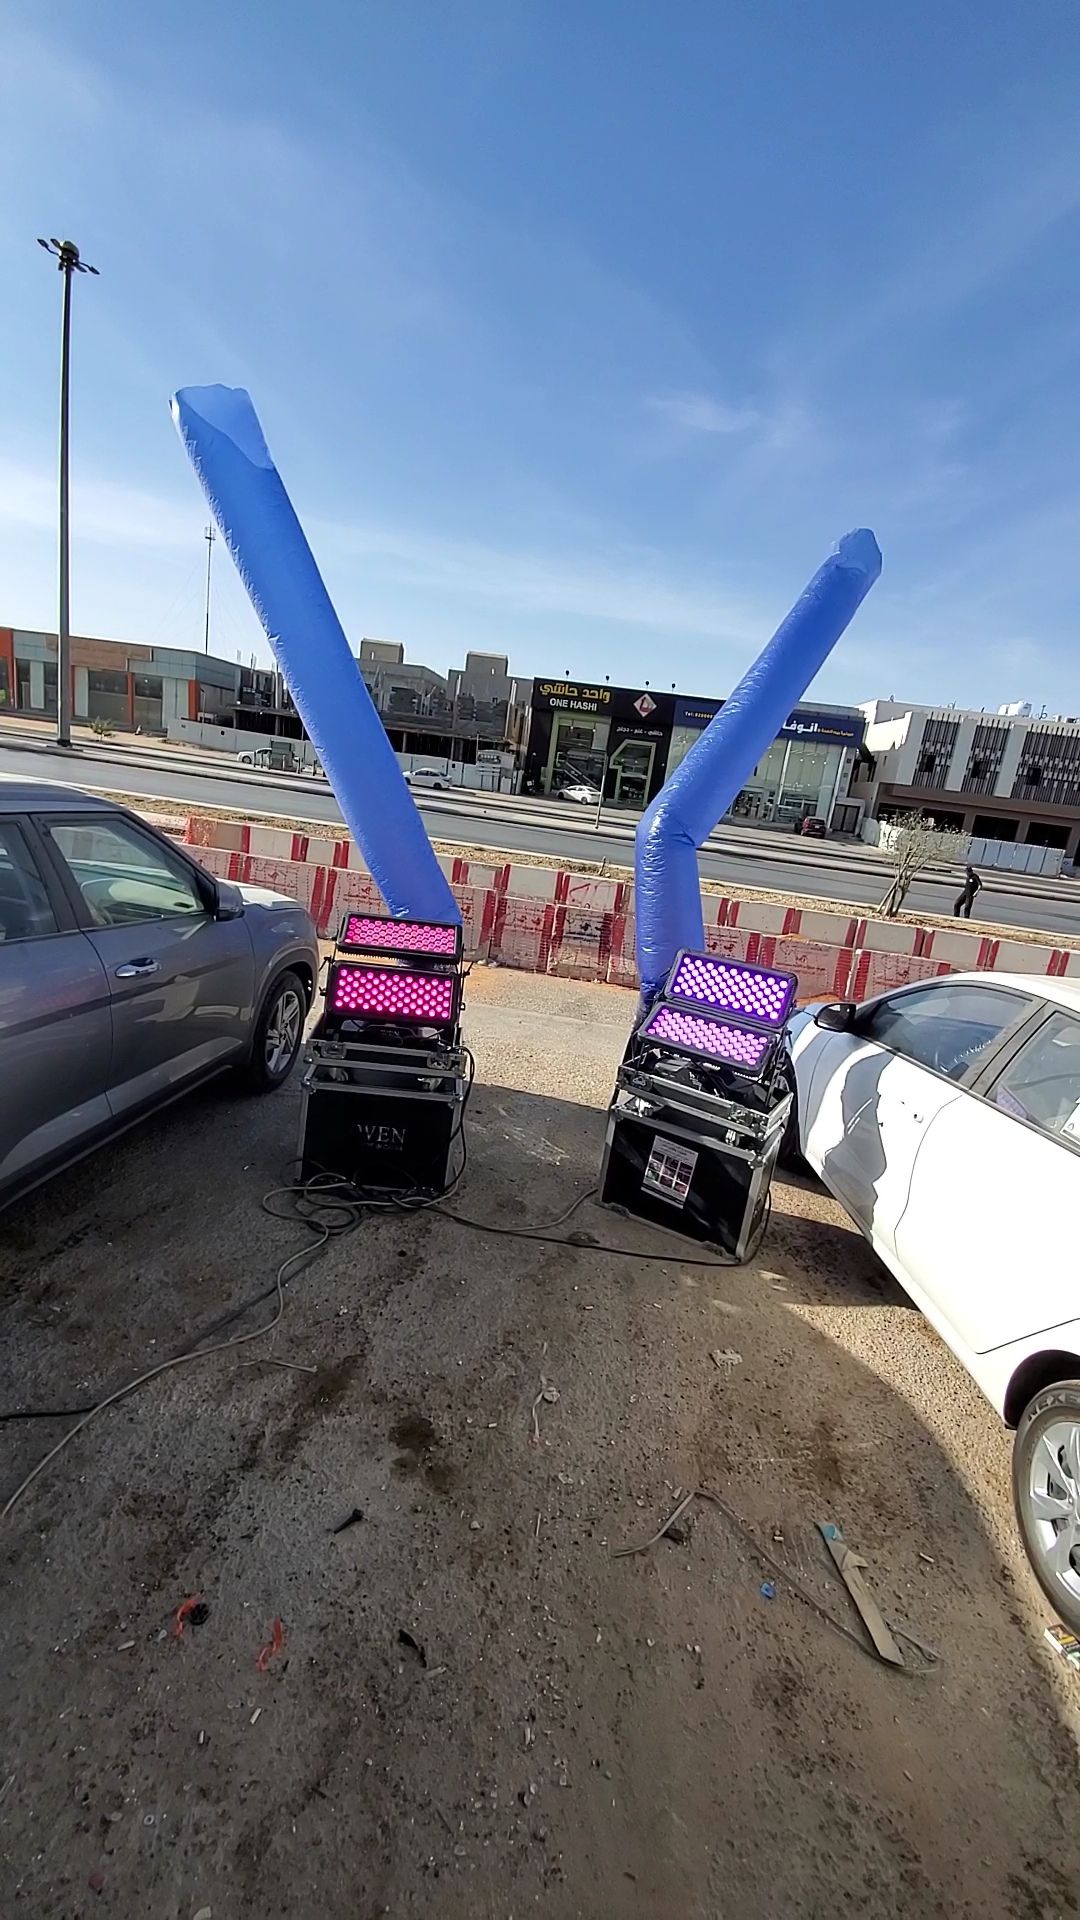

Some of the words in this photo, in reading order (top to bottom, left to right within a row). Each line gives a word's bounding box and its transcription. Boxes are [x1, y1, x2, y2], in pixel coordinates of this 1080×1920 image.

[539, 683, 578, 696] حاشي
[582, 688, 611, 704] واحد
[549, 697, 569, 708] ONE
[569, 699, 598, 712] HASHI
